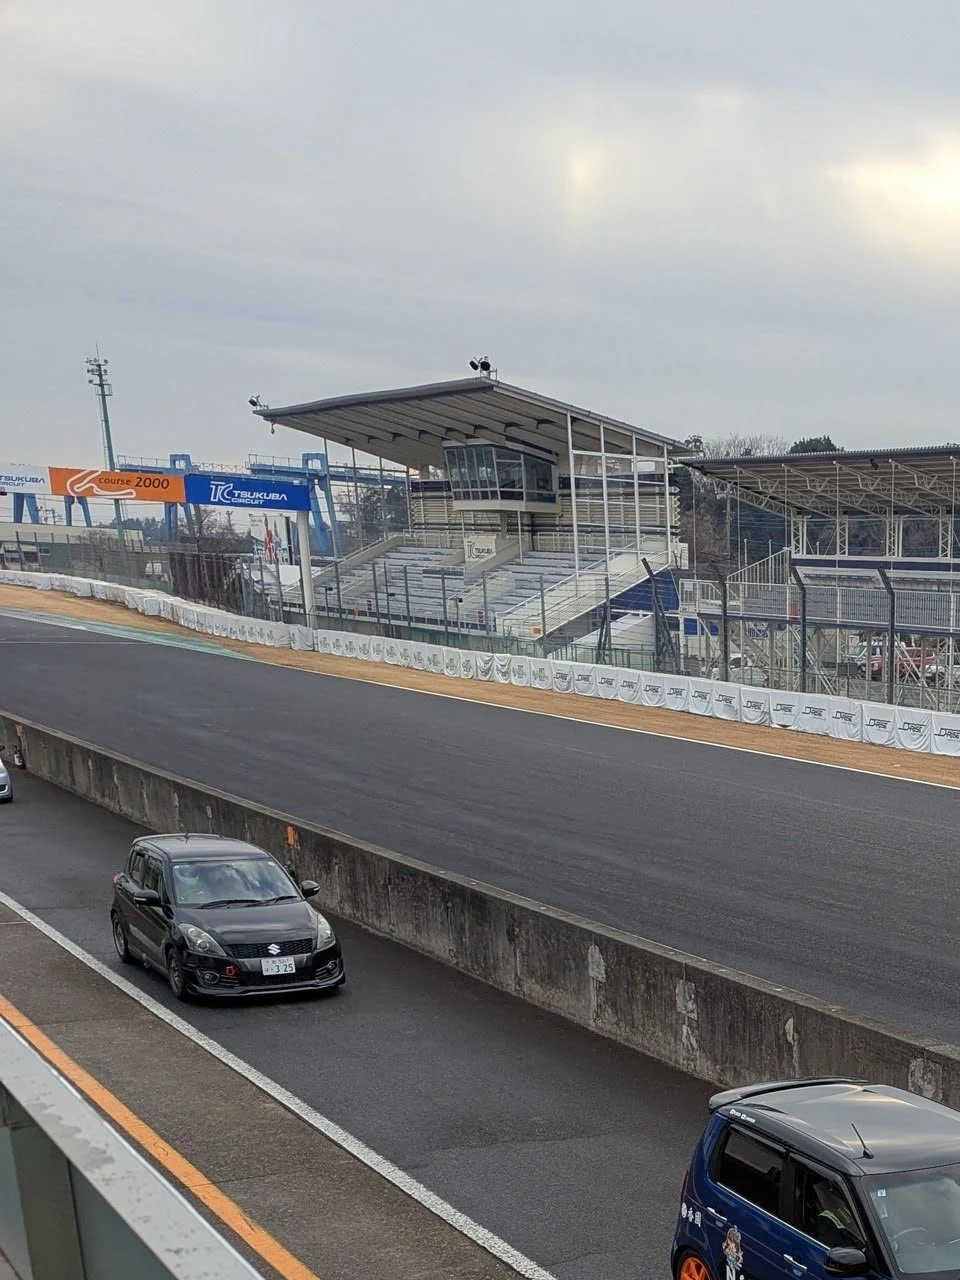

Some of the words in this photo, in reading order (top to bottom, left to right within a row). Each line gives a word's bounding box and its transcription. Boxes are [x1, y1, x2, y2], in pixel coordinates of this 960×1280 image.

[99, 477, 132, 485] course
[135, 476, 170, 489] 2000
[233, 490, 288, 501] TSUKUBA
